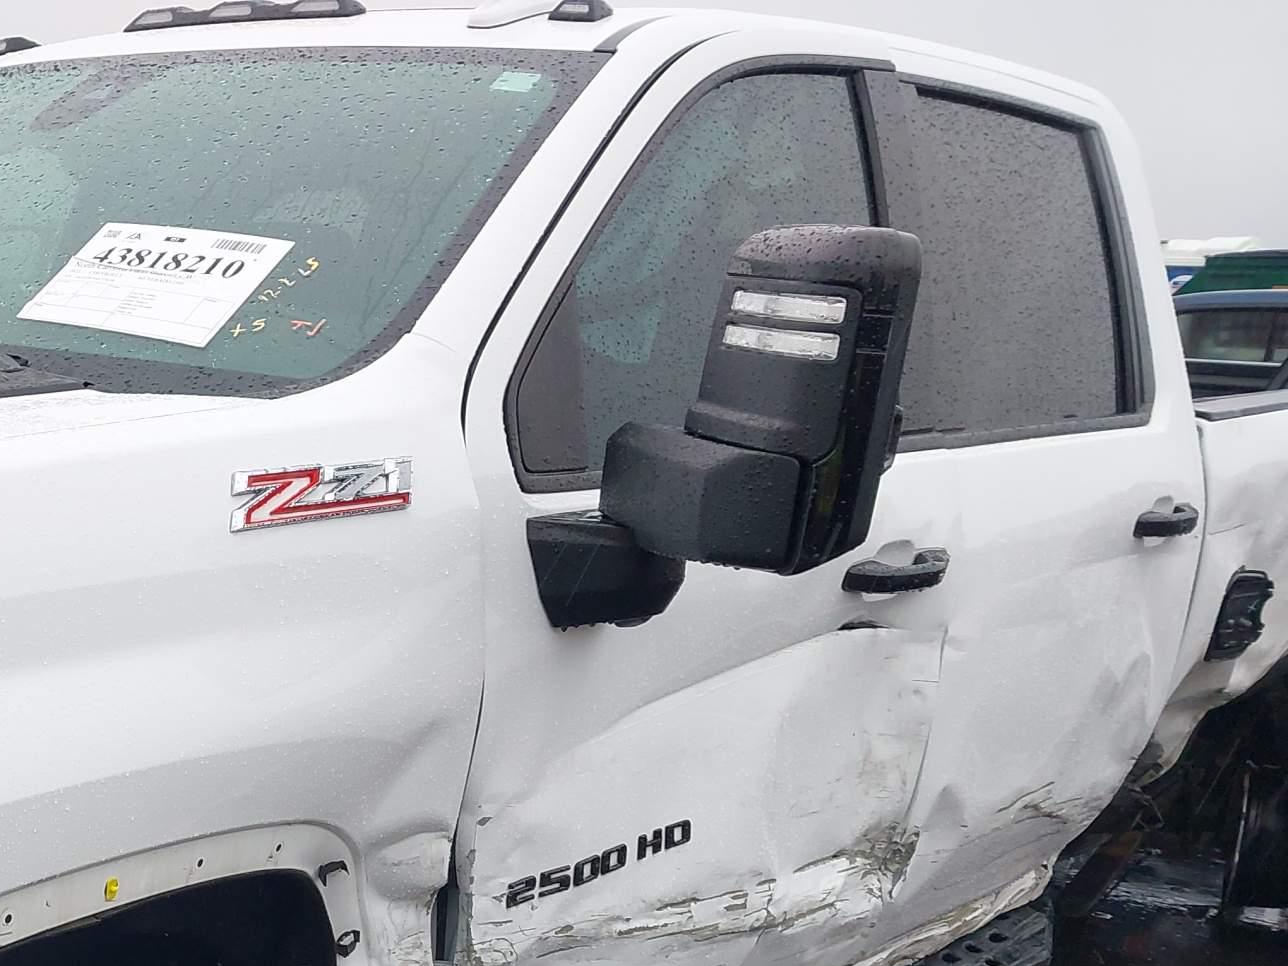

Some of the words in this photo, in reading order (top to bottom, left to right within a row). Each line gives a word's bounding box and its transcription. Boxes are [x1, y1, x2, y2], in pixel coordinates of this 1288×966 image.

[93, 246, 245, 279] 43818210
[230, 456, 413, 534] Z71
[506, 842, 627, 909] 2500
[637, 819, 692, 861] HD
